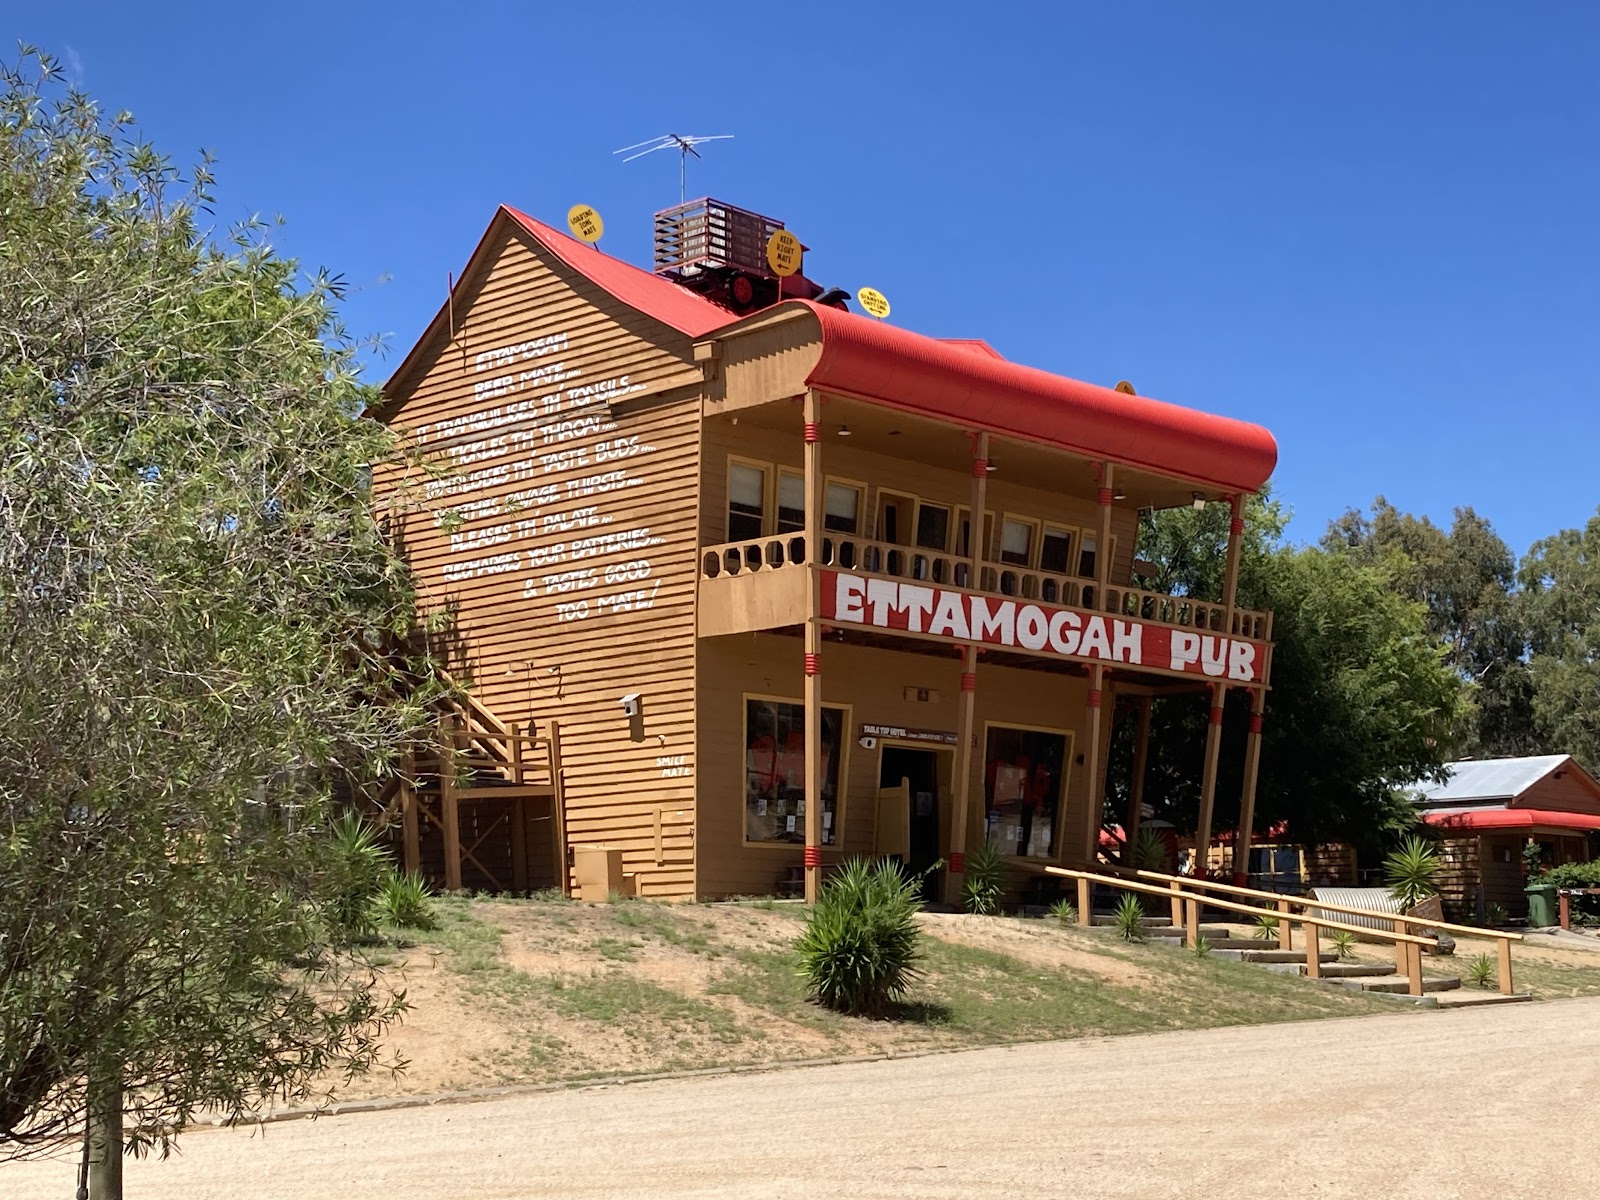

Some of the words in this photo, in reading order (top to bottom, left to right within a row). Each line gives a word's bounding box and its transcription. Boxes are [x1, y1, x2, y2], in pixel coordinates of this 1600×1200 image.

[776, 243, 795, 256] RIGHT
[776, 252, 791, 264] MATE
[474, 332, 568, 371] ETTAMOGAH
[474, 375, 516, 401] BEER
[416, 424, 432, 444] IT
[449, 434, 509, 466] TICKLES
[540, 447, 590, 473] TASTE
[450, 524, 512, 553] PLEASES
[442, 552, 523, 581] RECHARGES
[527, 542, 567, 568] YOUR
[523, 578, 538, 599] &
[542, 568, 599, 594] TASTES
[604, 559, 652, 585] GOOD
[555, 600, 590, 622] TOO
[833, 572, 1143, 668] ETTAMOGAH
[1169, 628, 1257, 683] PUB
[655, 754, 687, 767] SMILE
[661, 766, 691, 779] MATE
